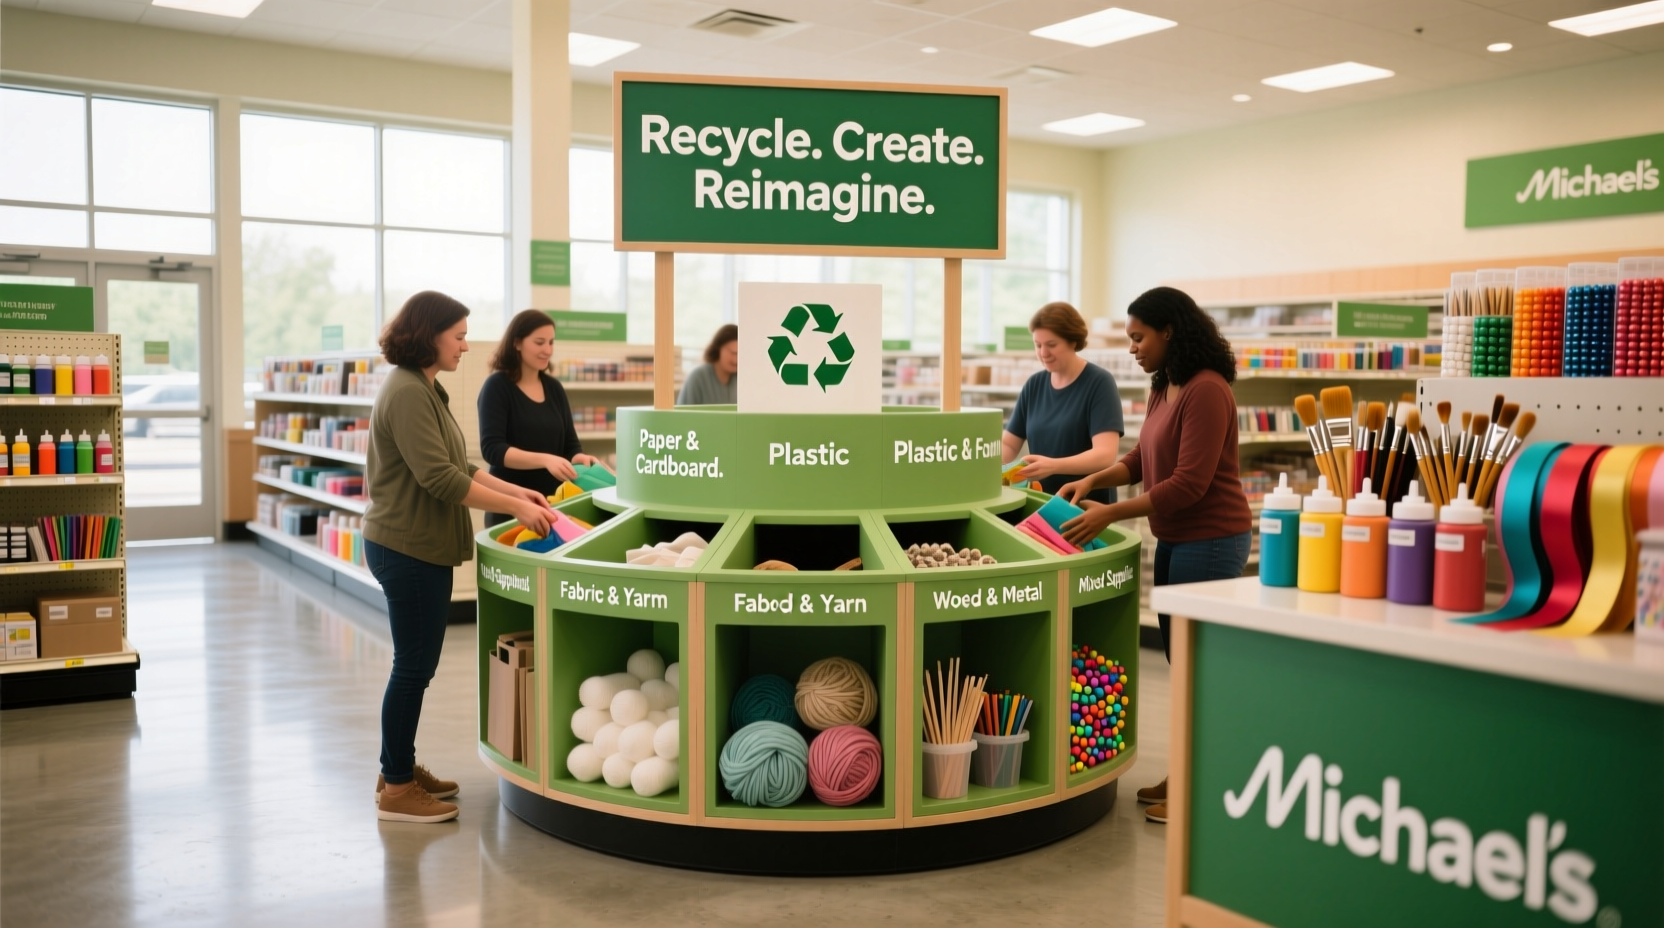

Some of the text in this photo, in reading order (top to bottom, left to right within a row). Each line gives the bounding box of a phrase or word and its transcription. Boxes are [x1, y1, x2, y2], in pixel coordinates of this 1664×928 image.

[641, 114, 984, 167] Recycle. Create.
[1516, 159, 1660, 203] Michael's
[695, 168, 935, 223] Reimagine.
[639, 428, 699, 454] Paper &
[769, 442, 850, 466] Plastic
[894, 438, 958, 464] Plastic
[962, 437, 972, 461] &
[636, 453, 724, 478] Cardboard.
[560, 580, 604, 604] Fabric
[607, 585, 619, 606] &
[799, 593, 814, 614] &
[819, 593, 868, 614] Yarn
[986, 587, 998, 607] &
[1002, 581, 1043, 605] Metal
[1223, 745, 1599, 925] Michael's
